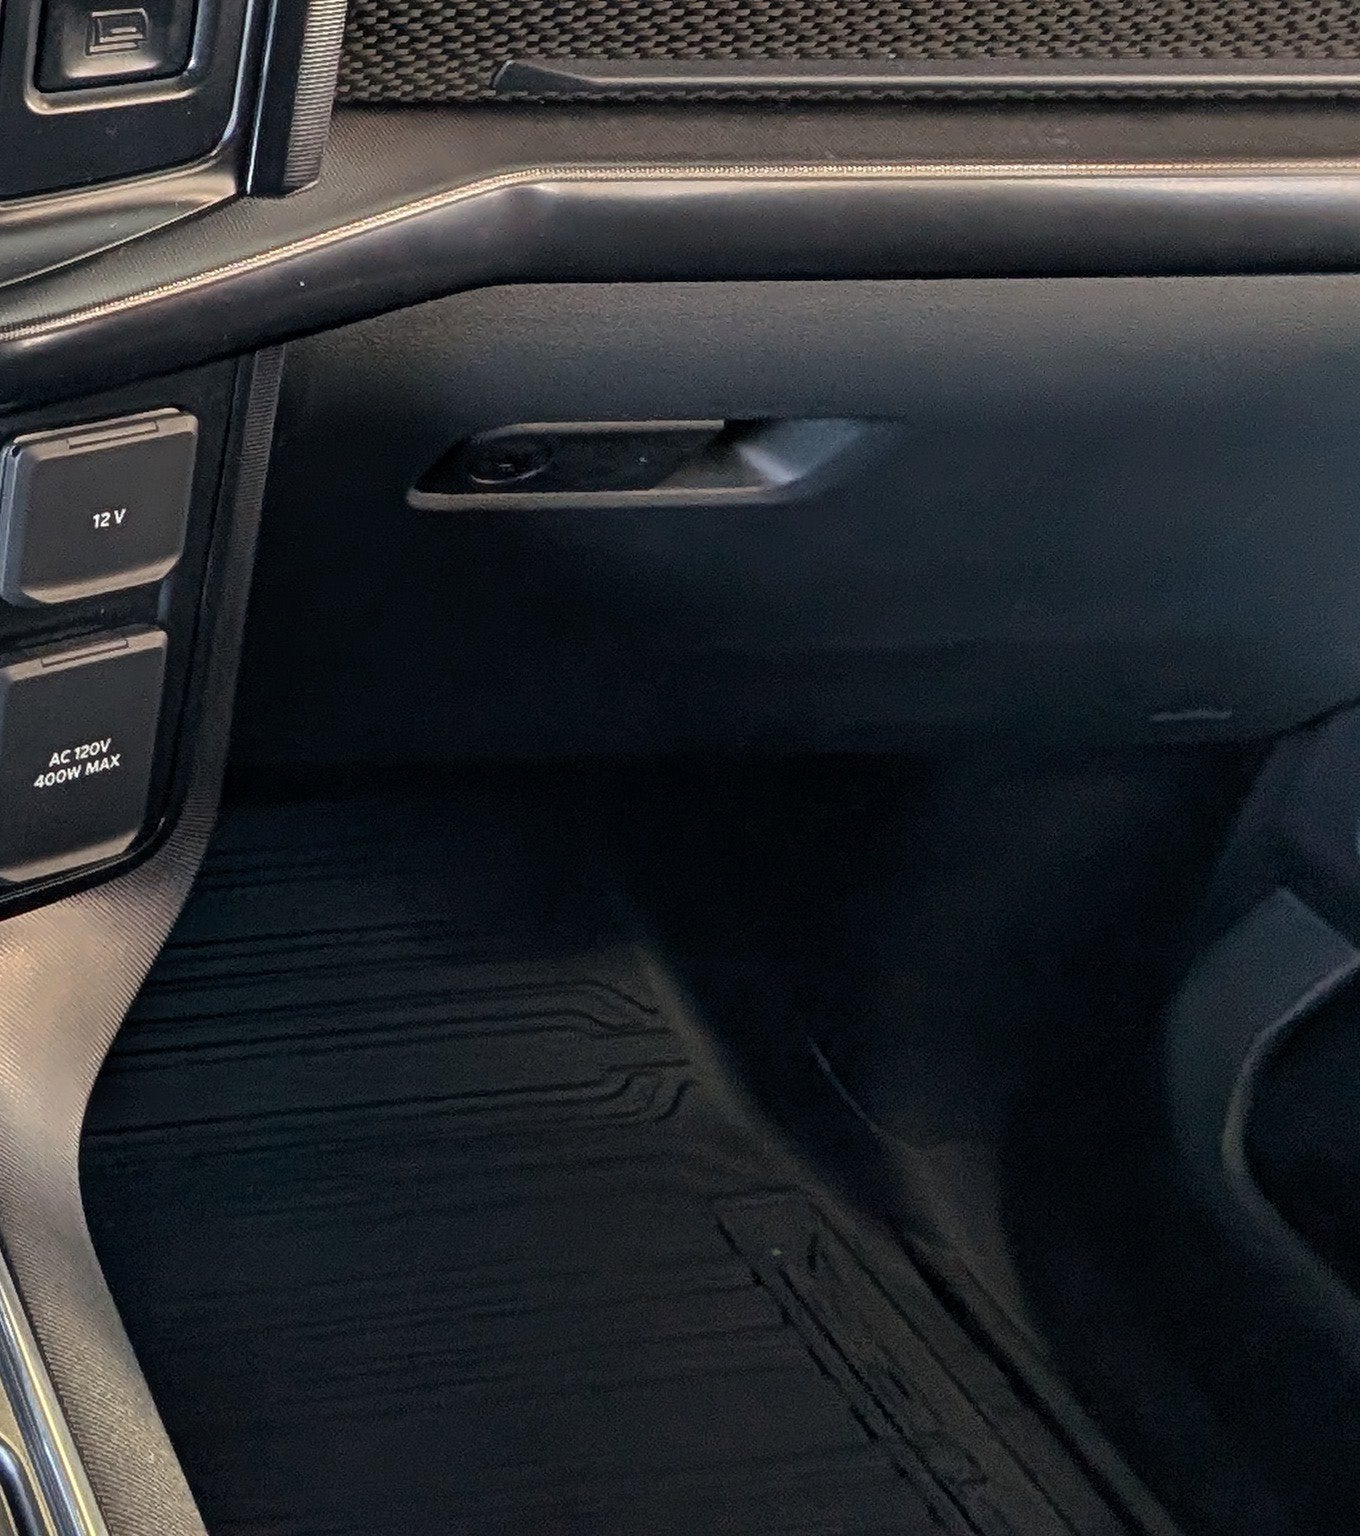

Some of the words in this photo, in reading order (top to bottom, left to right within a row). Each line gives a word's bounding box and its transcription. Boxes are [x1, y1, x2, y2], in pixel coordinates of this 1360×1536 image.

[92, 511, 111, 529] 12
[113, 508, 127, 524] V
[48, 749, 72, 767] AC
[73, 738, 112, 760] 120V
[33, 765, 83, 789] 400W
[84, 753, 121, 776] MAX
